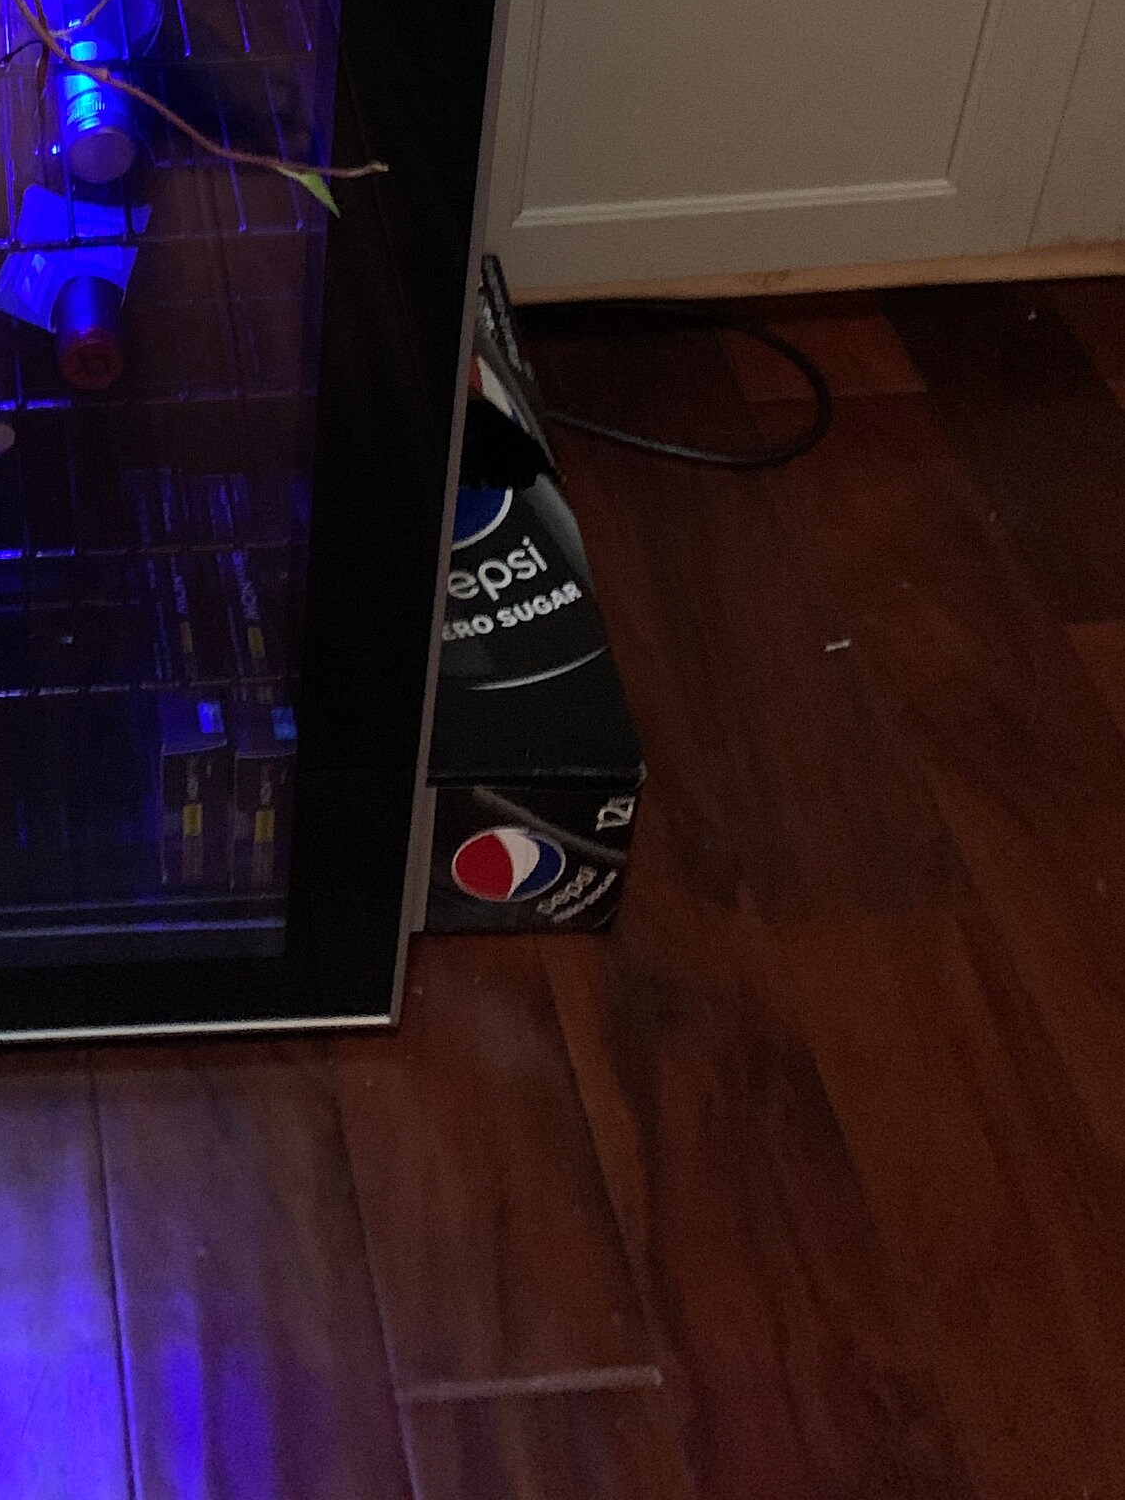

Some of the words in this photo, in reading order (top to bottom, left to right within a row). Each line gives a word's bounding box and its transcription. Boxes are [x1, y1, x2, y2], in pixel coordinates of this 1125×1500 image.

[447, 534, 548, 602] epsi
[441, 613, 495, 642] ERO
[495, 580, 583, 629] SUGAR
